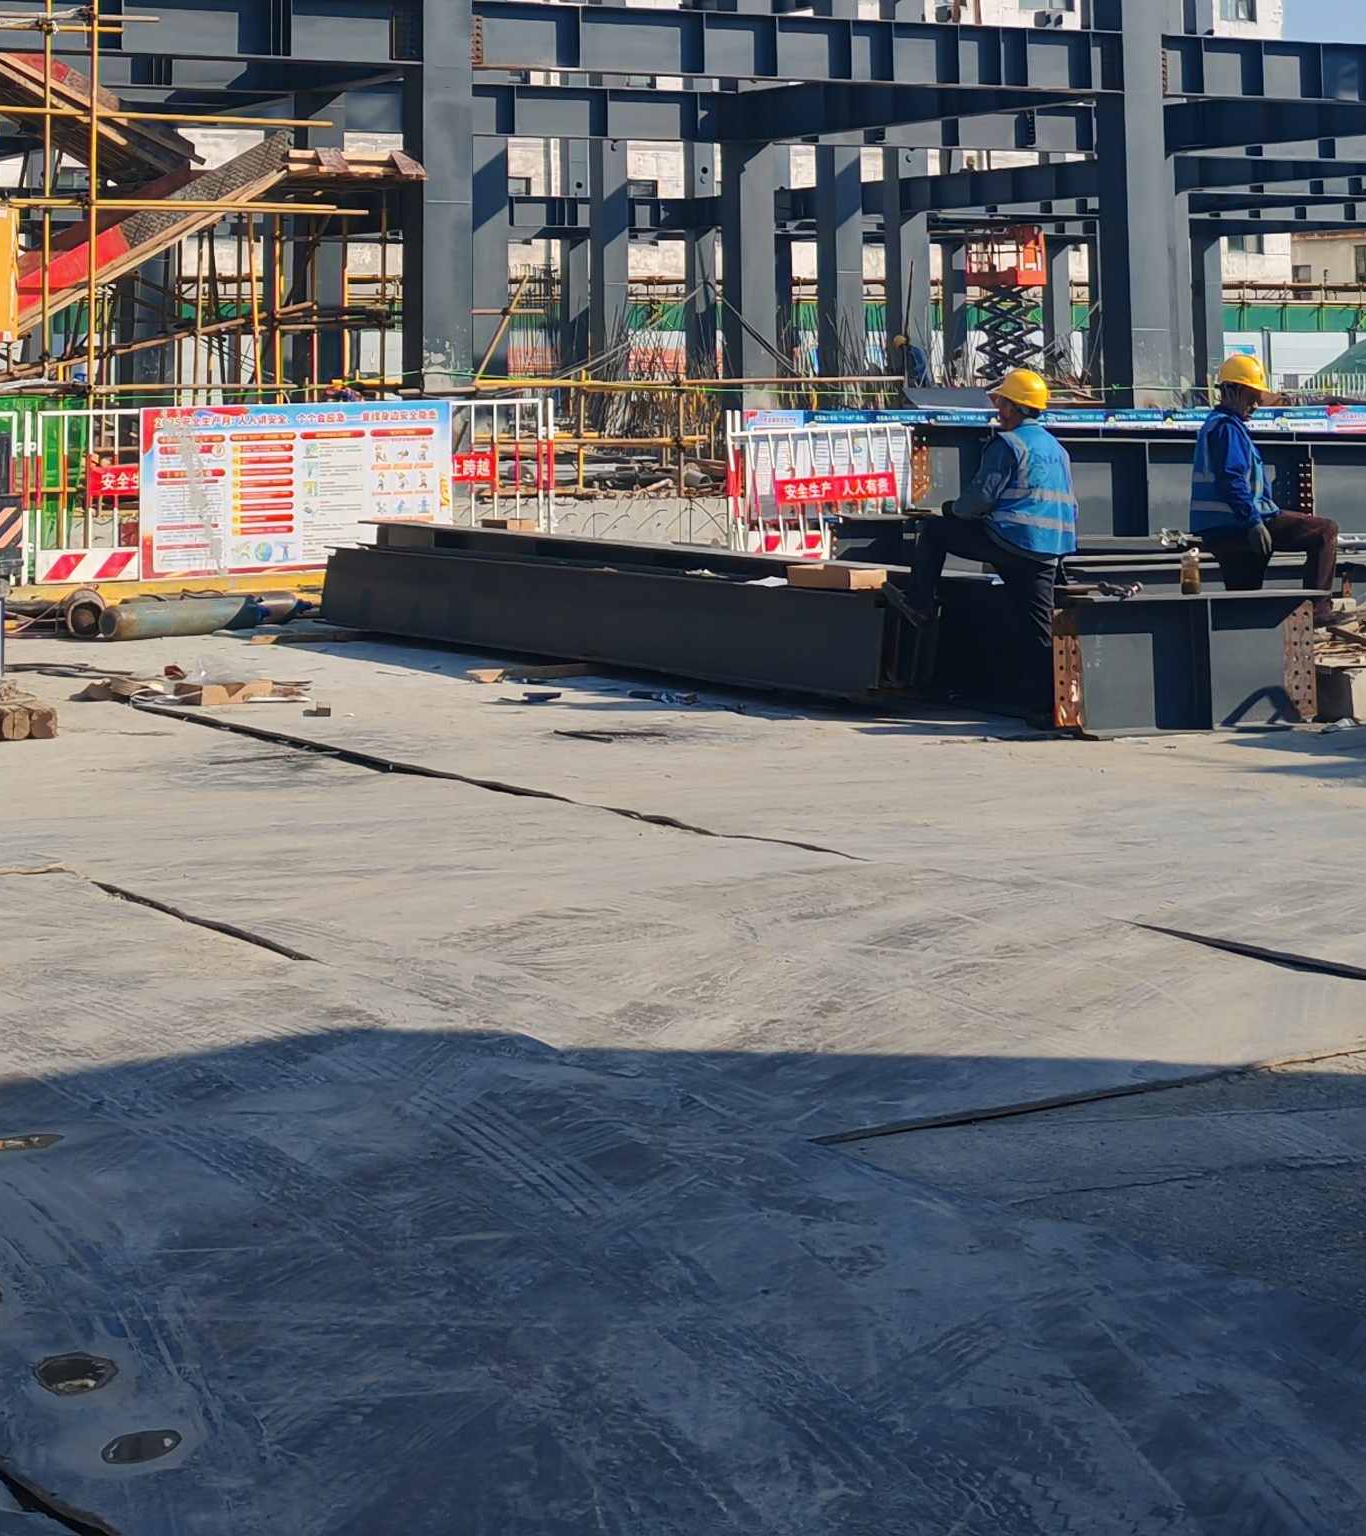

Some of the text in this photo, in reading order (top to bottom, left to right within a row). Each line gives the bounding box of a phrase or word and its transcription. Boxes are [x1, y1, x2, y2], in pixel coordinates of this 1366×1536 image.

[784, 477, 890, 501] 安全生产 人人有责
